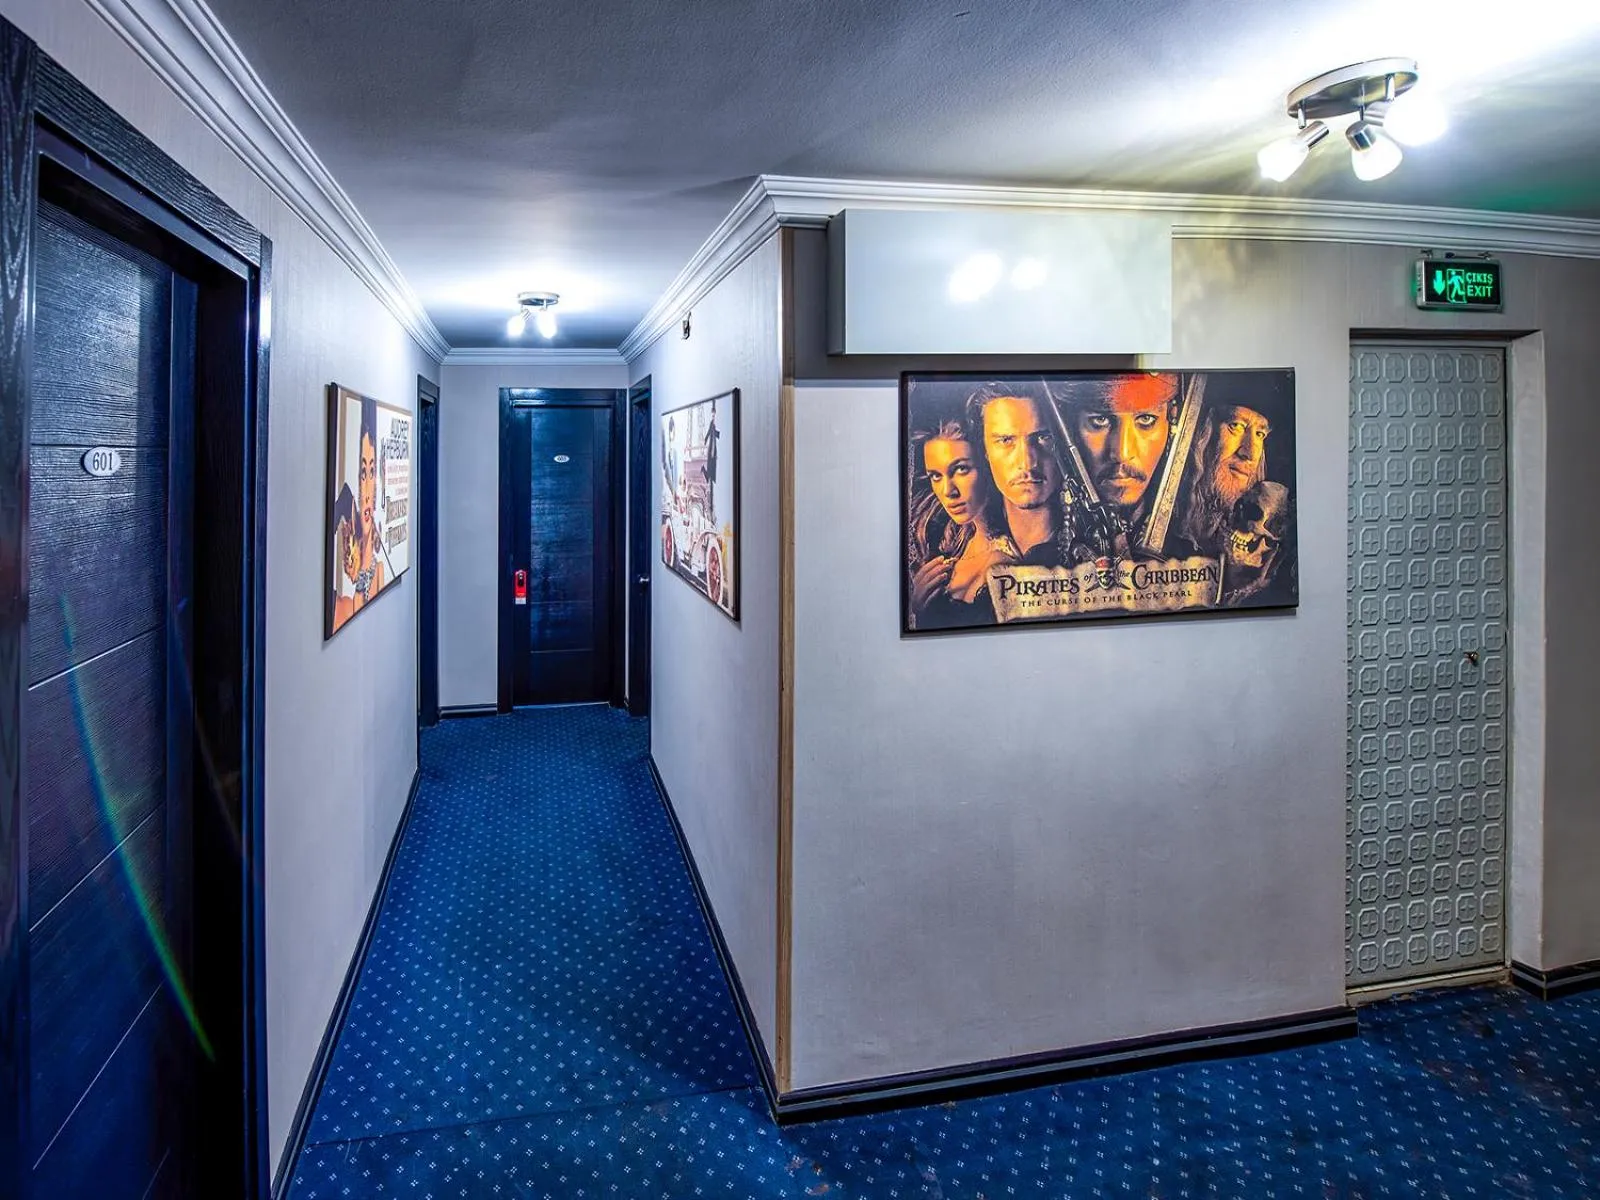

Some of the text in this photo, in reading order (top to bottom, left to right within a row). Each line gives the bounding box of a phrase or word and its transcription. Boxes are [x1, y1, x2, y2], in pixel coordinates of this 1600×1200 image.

[1467, 285, 1493, 297] EXIT
[92, 452, 113, 471] 601
[993, 574, 1080, 600] PIRATES
[1084, 573, 1093, 583] of
[1131, 564, 1219, 590] CARIBBEAN
[1047, 598, 1078, 606] CURSE
[1084, 596, 1097, 604] OF
[1126, 592, 1159, 600] BLACK
[1162, 590, 1192, 598] PEARL
